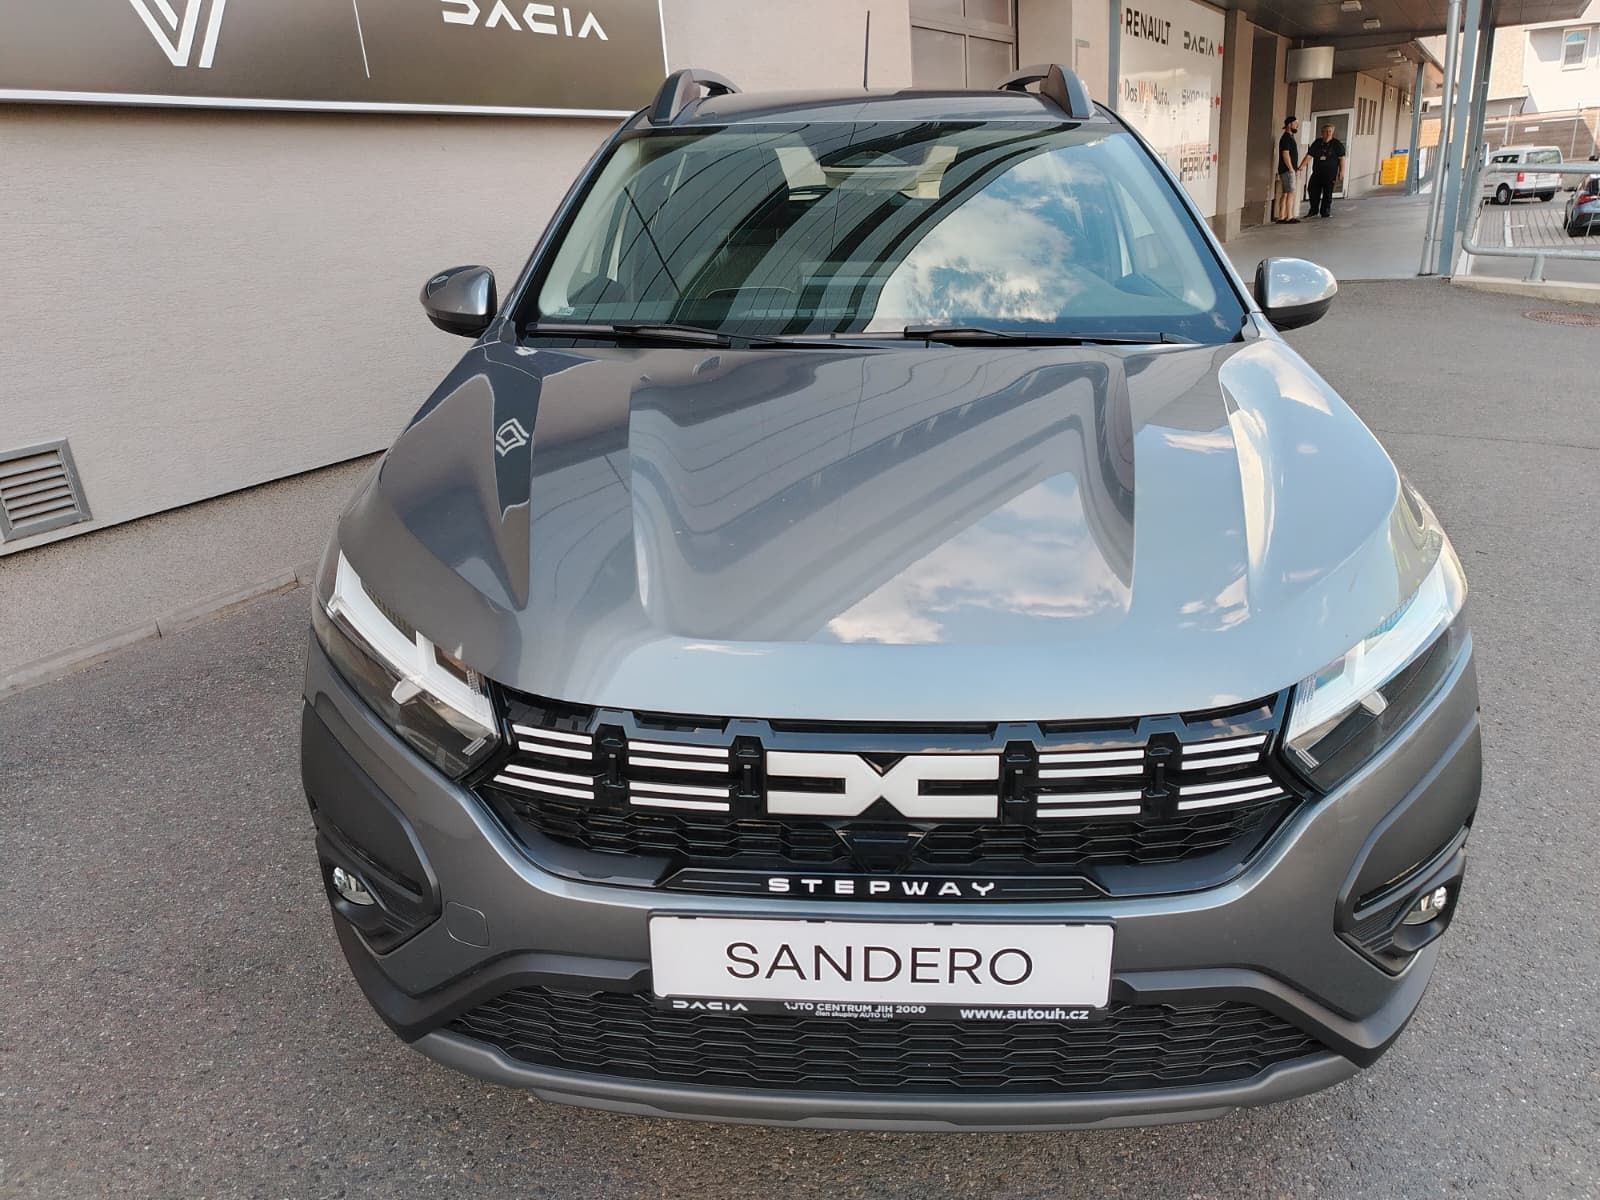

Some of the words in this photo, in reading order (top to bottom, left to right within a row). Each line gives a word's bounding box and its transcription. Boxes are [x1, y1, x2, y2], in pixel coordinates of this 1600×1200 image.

[441, 0, 609, 41] DACIA
[1125, 7, 1171, 47] RENAULT
[1183, 30, 1215, 57] DACIA
[768, 877, 995, 898] STEPWAY
[725, 942, 1033, 986] SANDERO
[672, 1000, 749, 1012] DACIA
[816, 1003, 873, 1013] CENTRUM
[874, 1004, 894, 1014] JIH
[895, 1005, 927, 1014] 2000
[960, 1007, 1089, 1020] www.autouh.cz
